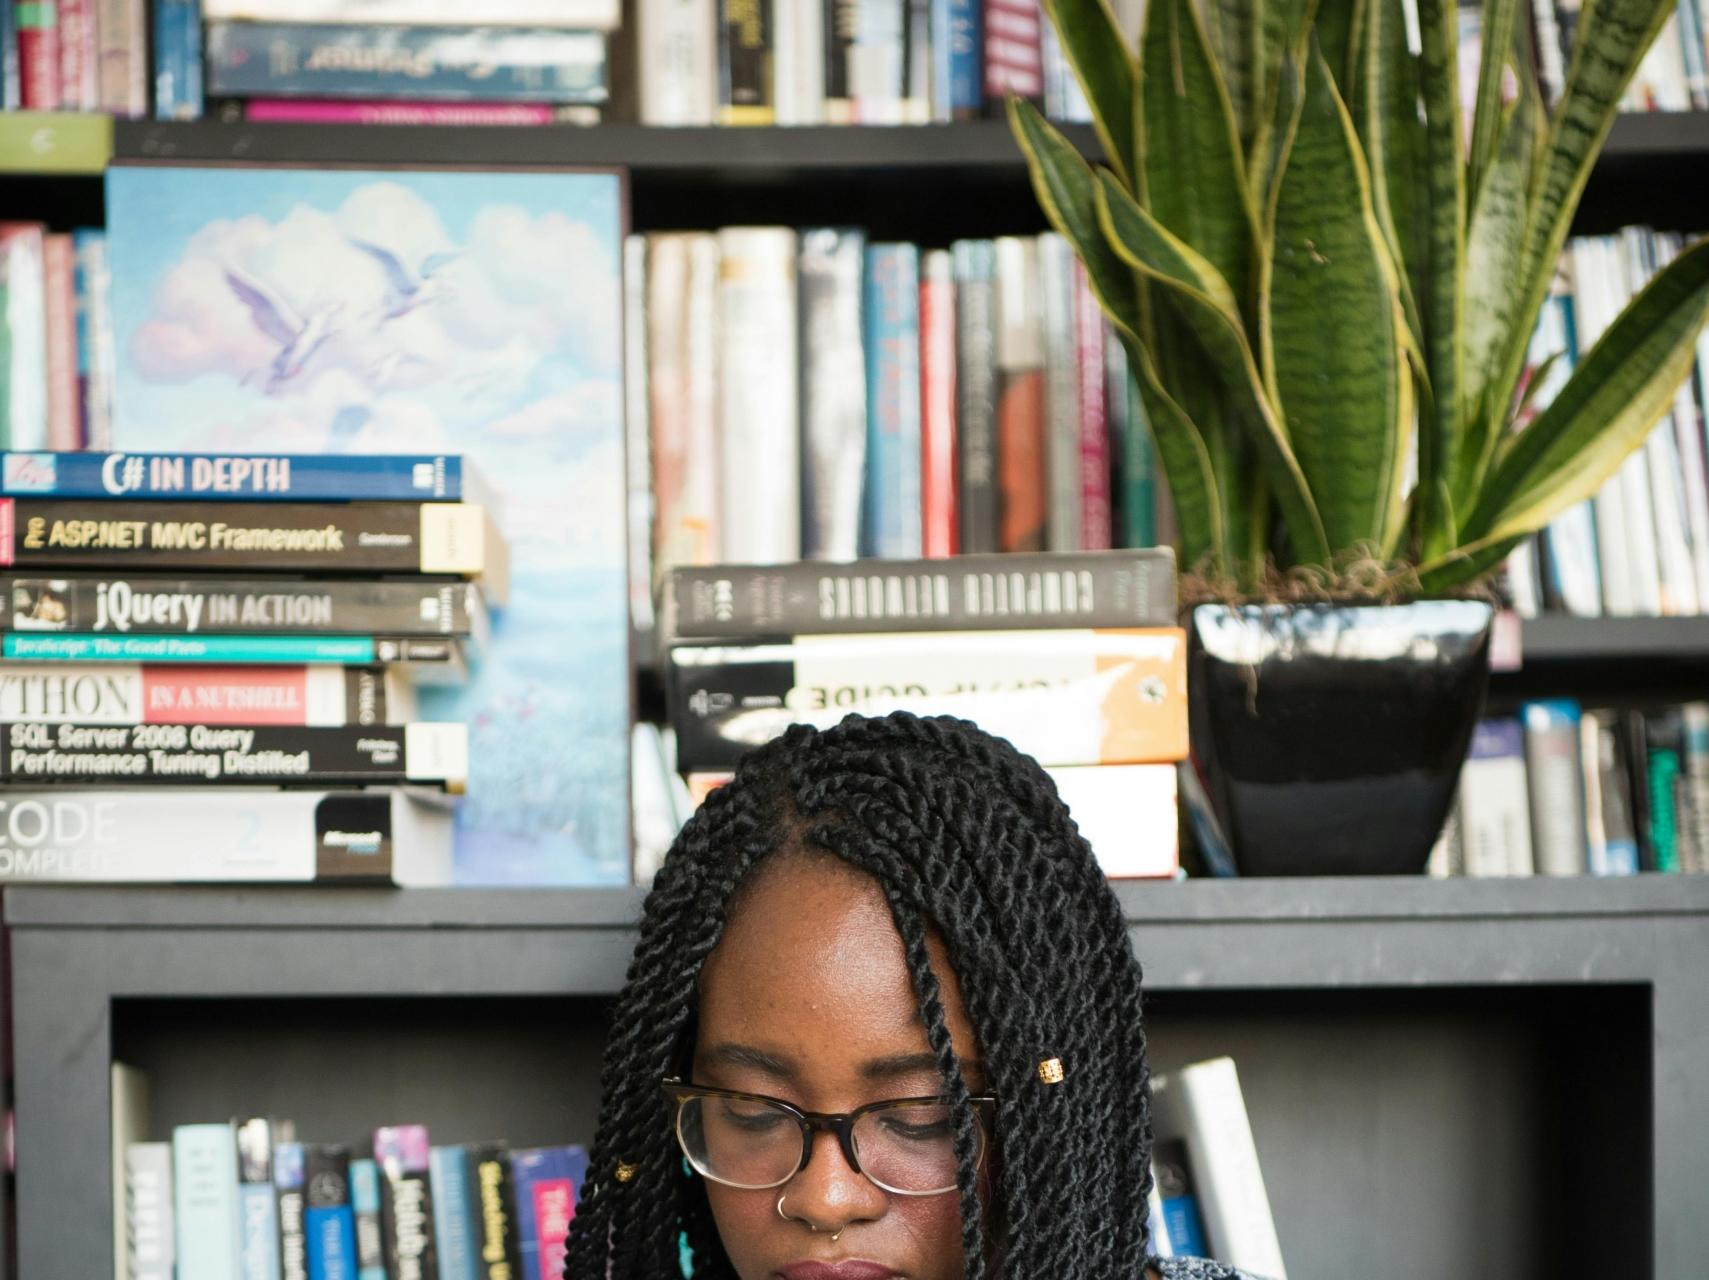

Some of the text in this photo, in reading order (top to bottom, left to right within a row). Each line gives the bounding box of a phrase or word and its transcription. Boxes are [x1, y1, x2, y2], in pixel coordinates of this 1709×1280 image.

[102, 453, 290, 495] C# IN DEPTH
[48, 520, 148, 549] ASP.NET
[151, 522, 206, 549] MVC
[209, 523, 344, 552] Framework
[93, 581, 332, 632] jQuery IN ACTION
[818, 574, 950, 619] NETWORKS
[963, 569, 1095, 614] COMPUTER
[0, 674, 131, 715] THON
[177, 685, 195, 709] A
[196, 685, 300, 710] NUTSHELL
[10, 721, 255, 753] SQL Server 2008 Query
[10, 749, 310, 780] Performance Tuning Distilled
[541, 1188, 569, 1237] THE
